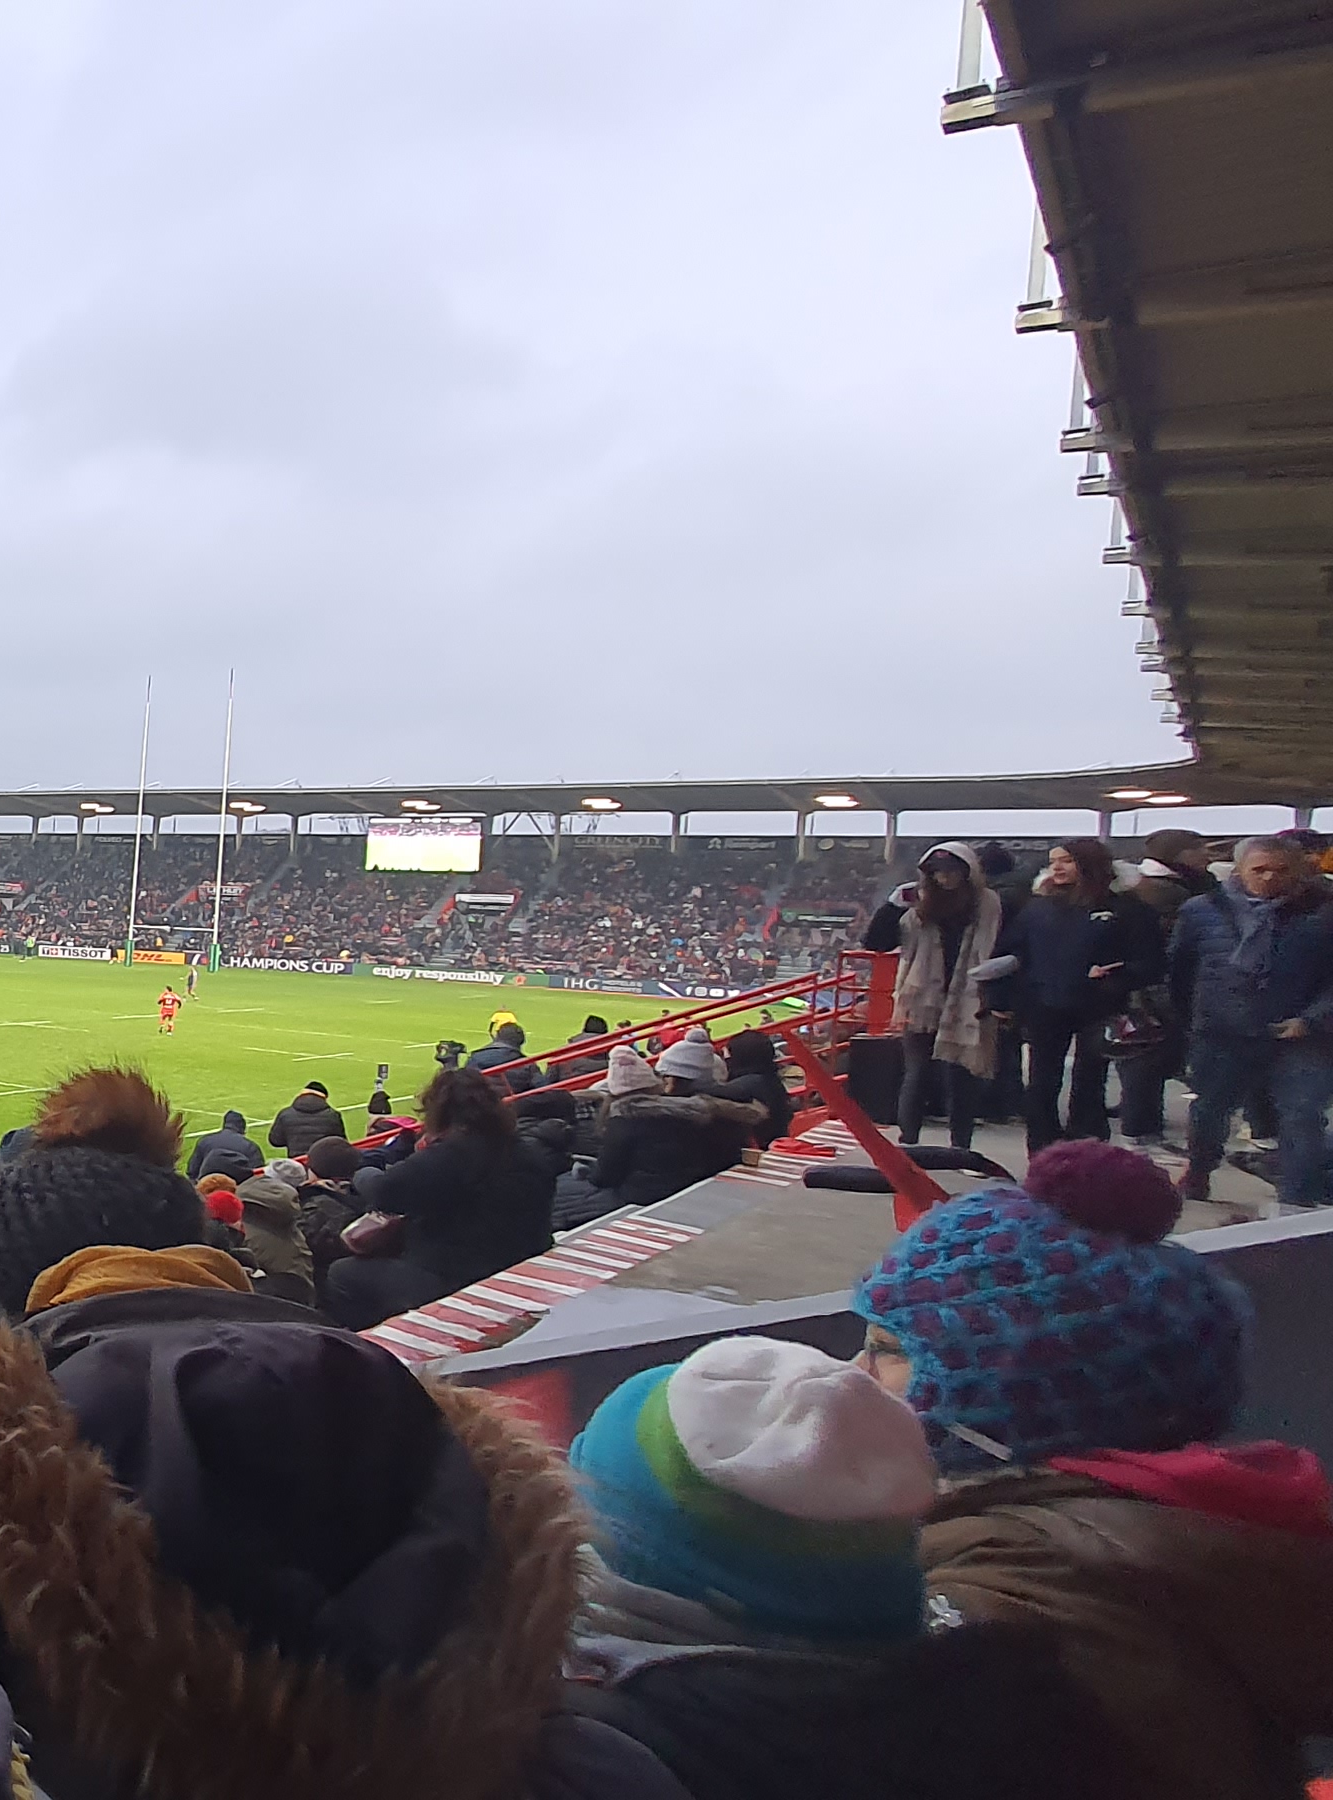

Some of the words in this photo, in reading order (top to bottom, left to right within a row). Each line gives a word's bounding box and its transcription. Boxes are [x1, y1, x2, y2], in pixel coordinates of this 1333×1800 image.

[61, 948, 107, 959] TISSOT
[133, 952, 165, 963] DHL
[311, 961, 345, 974] CUP
[372, 966, 413, 980] enjoy
[415, 969, 504, 986] responsibly
[563, 977, 599, 990] IHG
